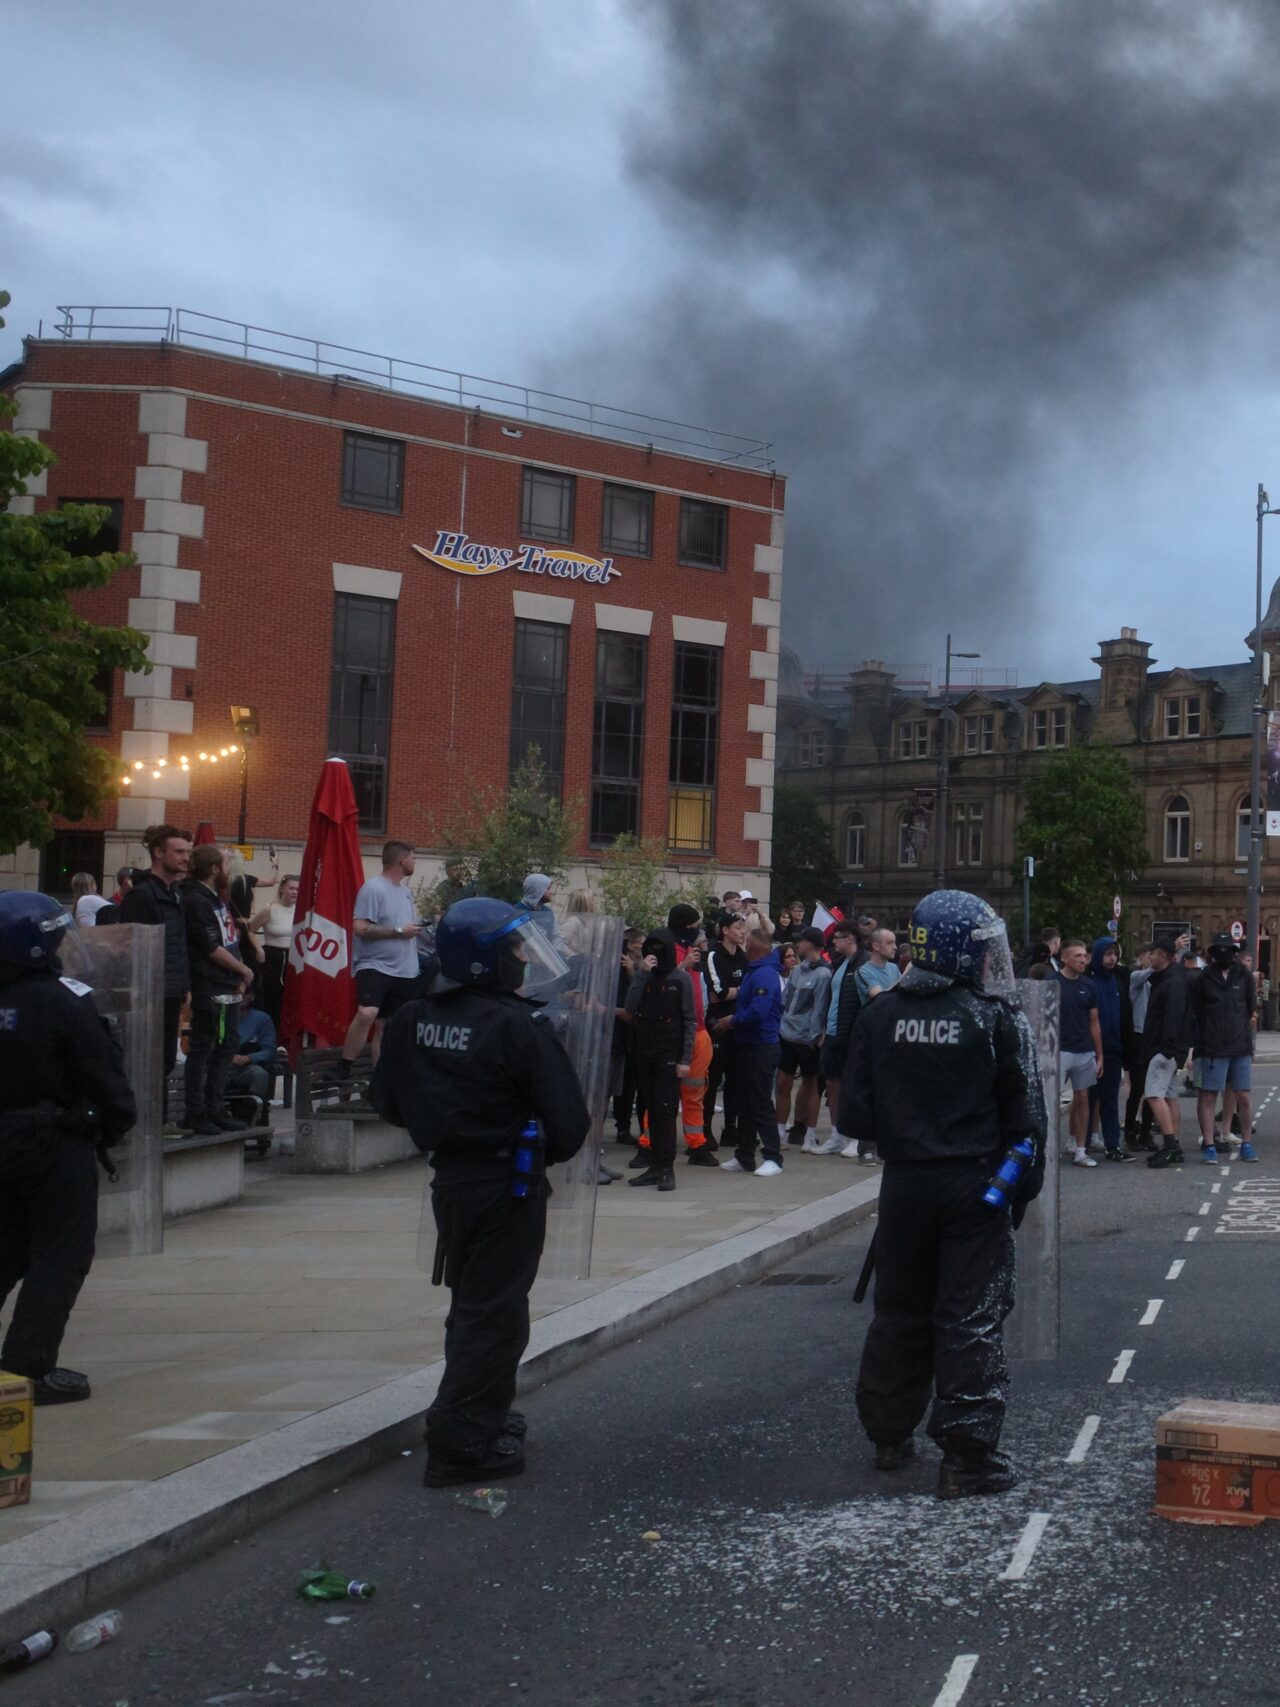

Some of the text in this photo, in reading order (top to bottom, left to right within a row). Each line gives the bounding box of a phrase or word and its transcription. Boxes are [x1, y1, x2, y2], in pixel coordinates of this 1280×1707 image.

[432, 531, 614, 583] Hays Travel
[416, 1022, 472, 1051] POLICE
[894, 1018, 961, 1044] POLICE
[1191, 1483, 1211, 1505] 24
[1226, 1485, 1250, 1497] MAX
